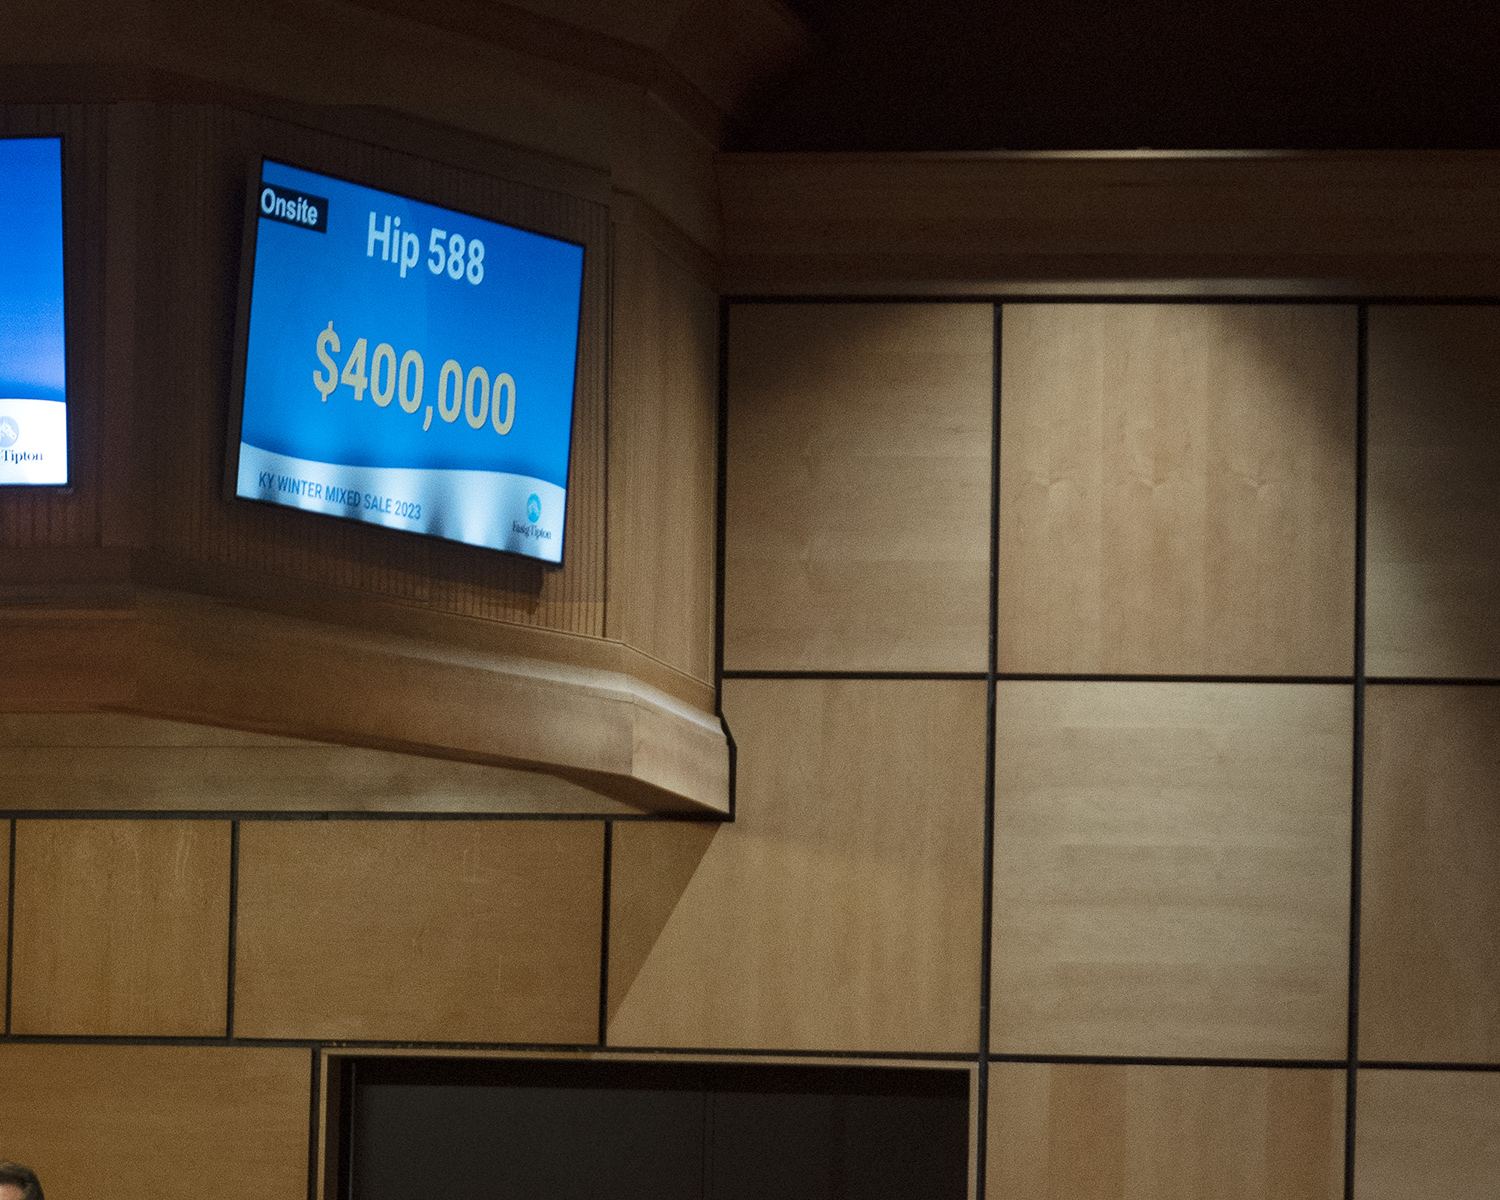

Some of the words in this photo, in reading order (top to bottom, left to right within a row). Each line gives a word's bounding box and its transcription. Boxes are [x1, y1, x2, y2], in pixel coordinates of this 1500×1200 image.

[260, 187, 319, 226] Onsite
[366, 211, 420, 279] Hip
[427, 227, 486, 286] 588
[312, 320, 517, 436] $400,000
[258, 471, 275, 489] KY
[278, 475, 322, 500] WINTER
[325, 485, 361, 508] MIXED
[364, 493, 393, 514] SALE
[395, 500, 422, 520] 2023
